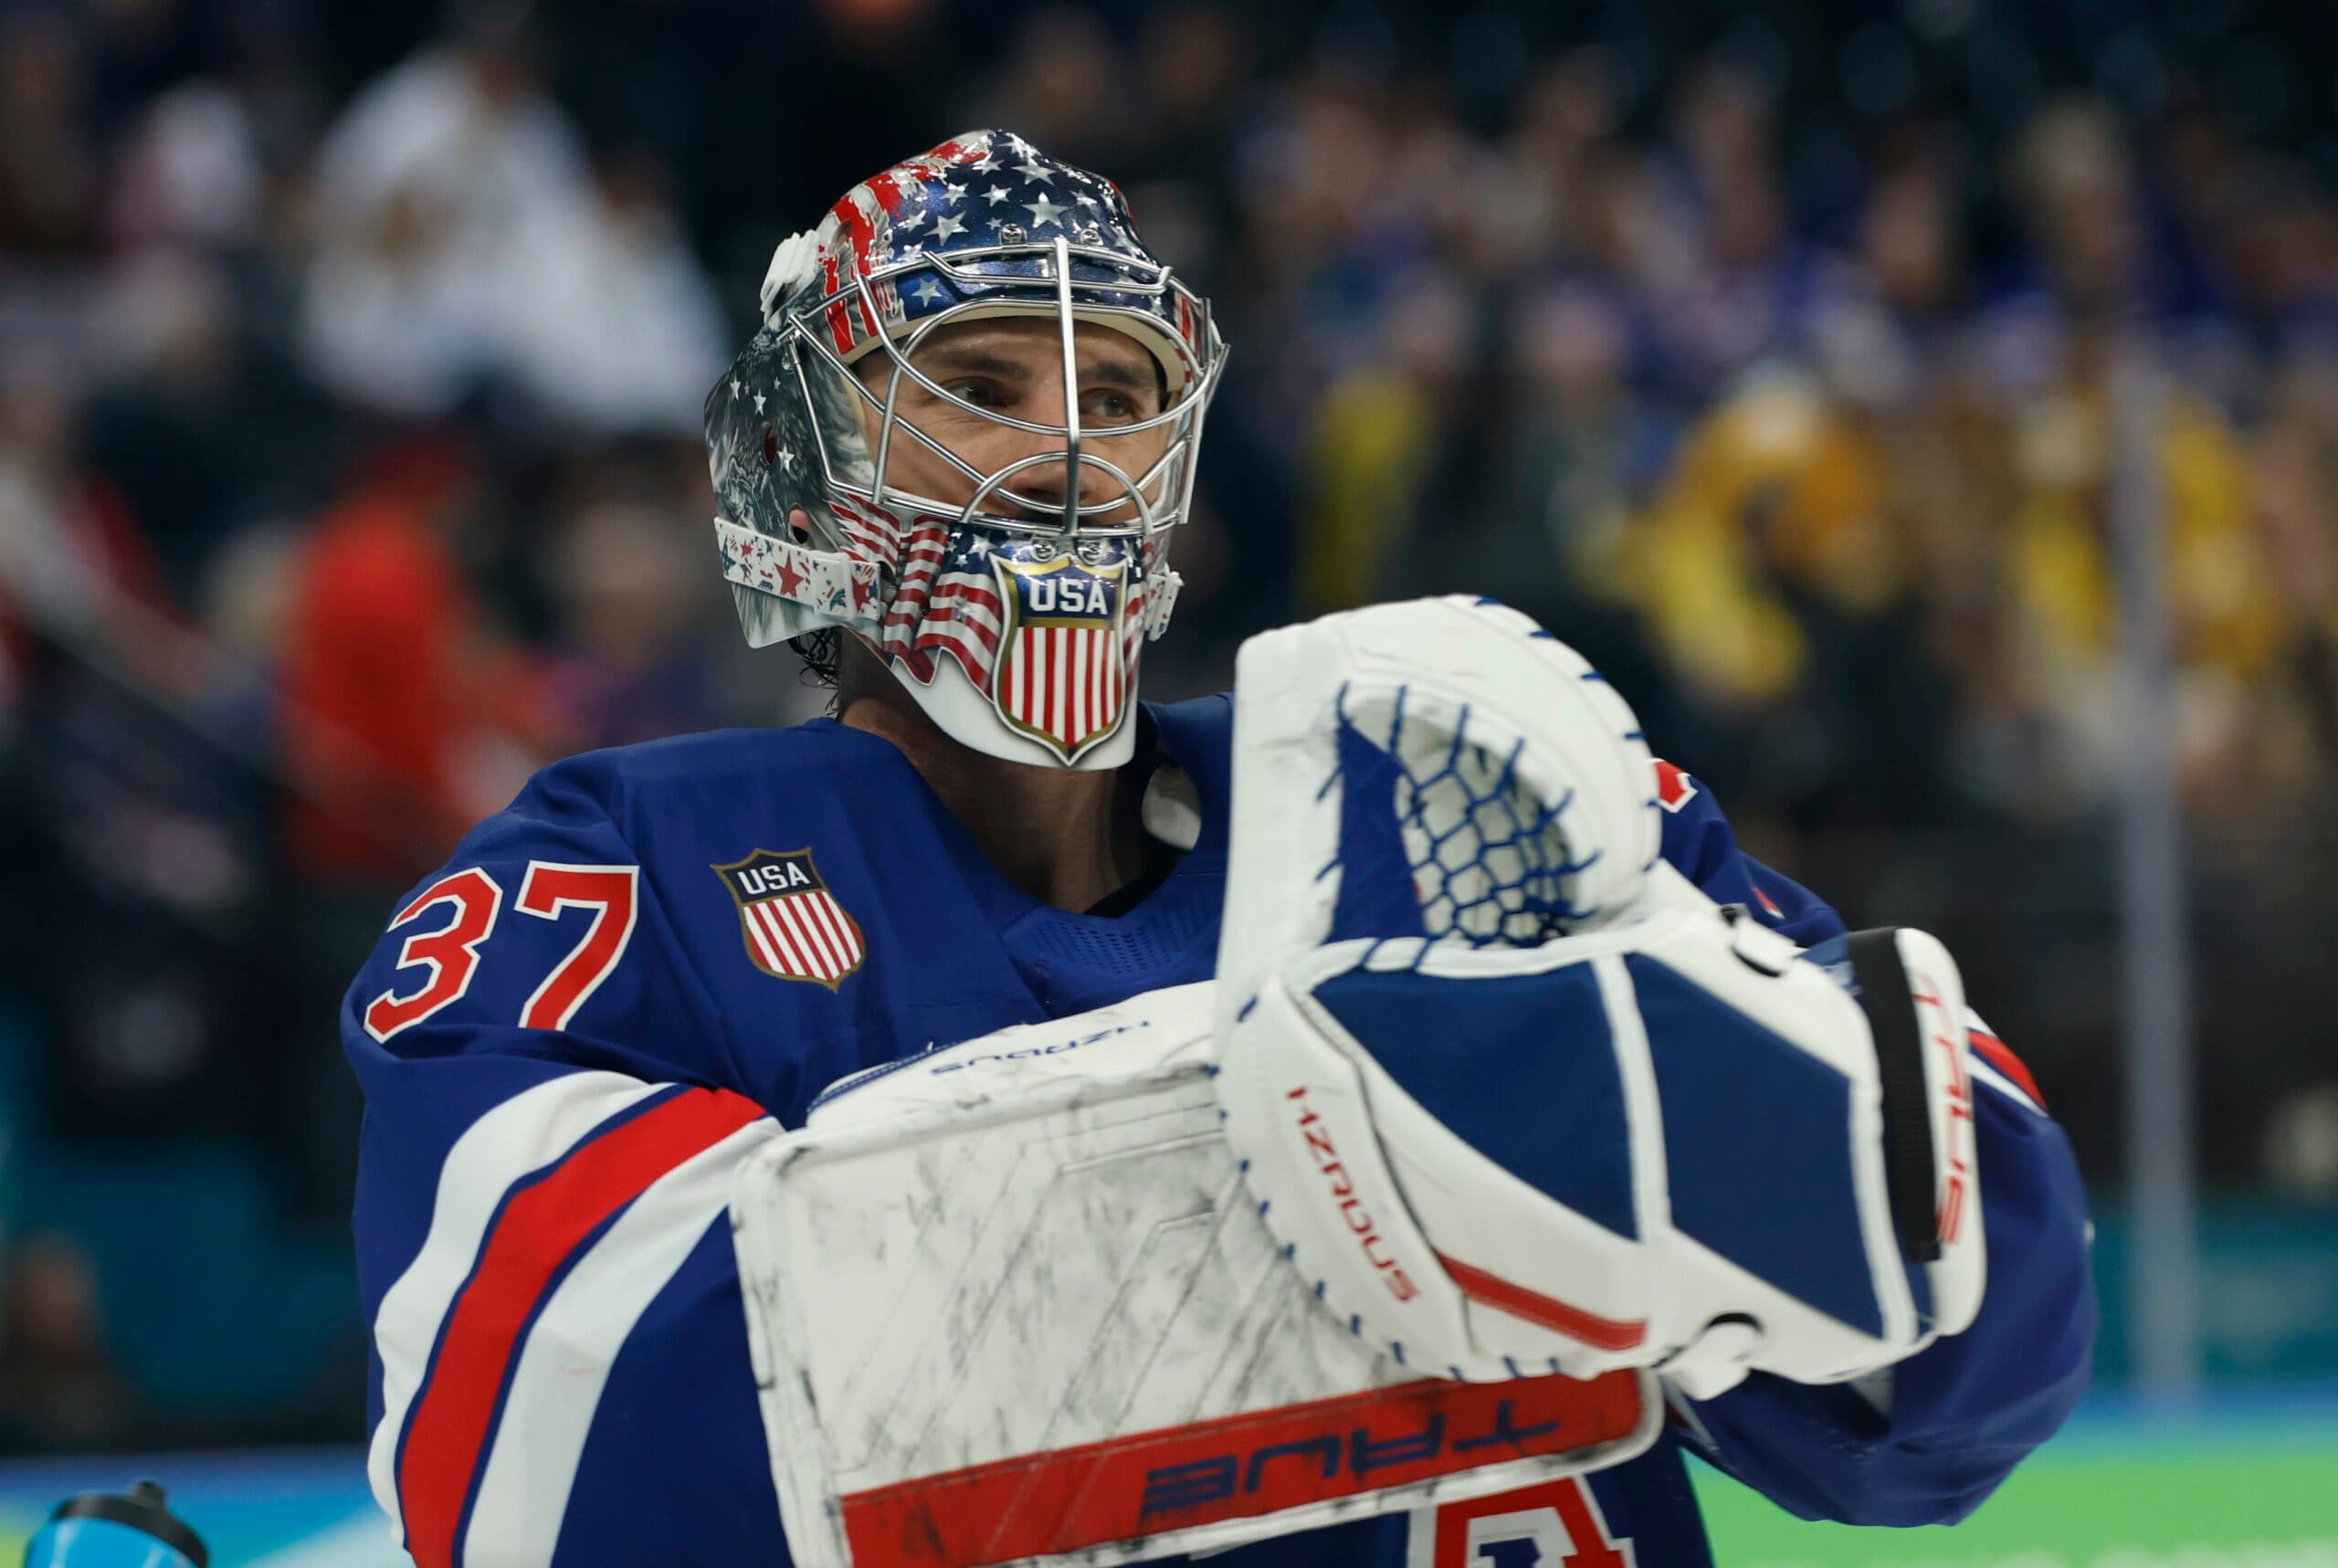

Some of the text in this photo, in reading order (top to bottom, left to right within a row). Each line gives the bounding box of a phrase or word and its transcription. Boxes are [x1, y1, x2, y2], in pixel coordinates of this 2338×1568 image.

[1028, 577, 1109, 616] USA
[736, 861, 812, 896] USA
[363, 859, 640, 1044] 37
[1141, 1399, 1563, 1514] TRUE
